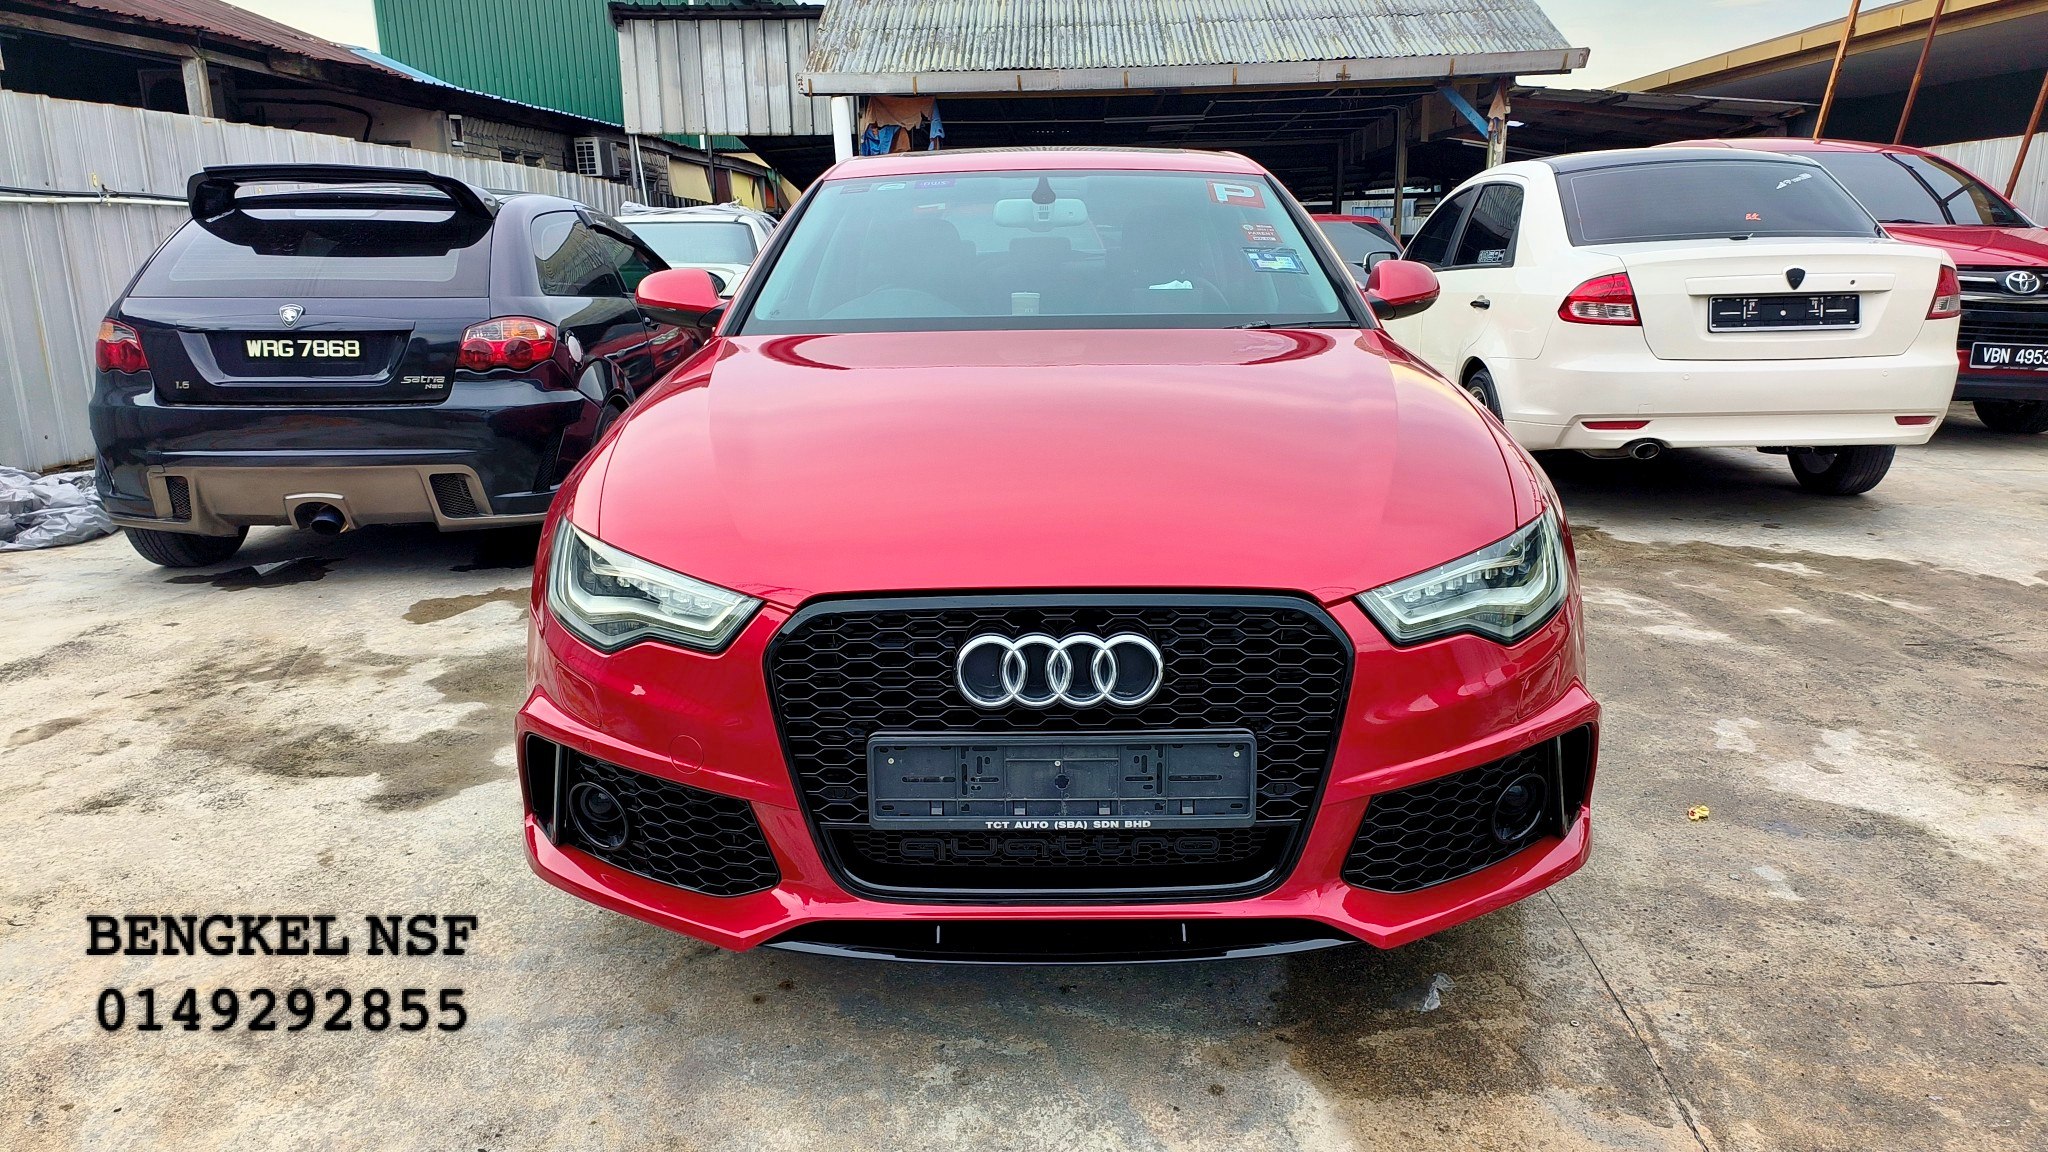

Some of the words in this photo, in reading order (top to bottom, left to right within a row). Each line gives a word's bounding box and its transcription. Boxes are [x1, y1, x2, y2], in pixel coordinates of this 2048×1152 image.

[1212, 183, 1255, 202] P
[246, 339, 295, 357] WRG
[297, 339, 361, 357] 7868
[1983, 347, 2011, 364] VBN
[2015, 348, 2048, 365] 4953
[985, 821, 1009, 829] TCT
[1014, 821, 1049, 829] AUTO
[1054, 820, 1088, 829] (SBA)
[1093, 820, 1119, 829] SDN
[1124, 820, 1152, 828] BHD
[900, 835, 1220, 861] quattro
